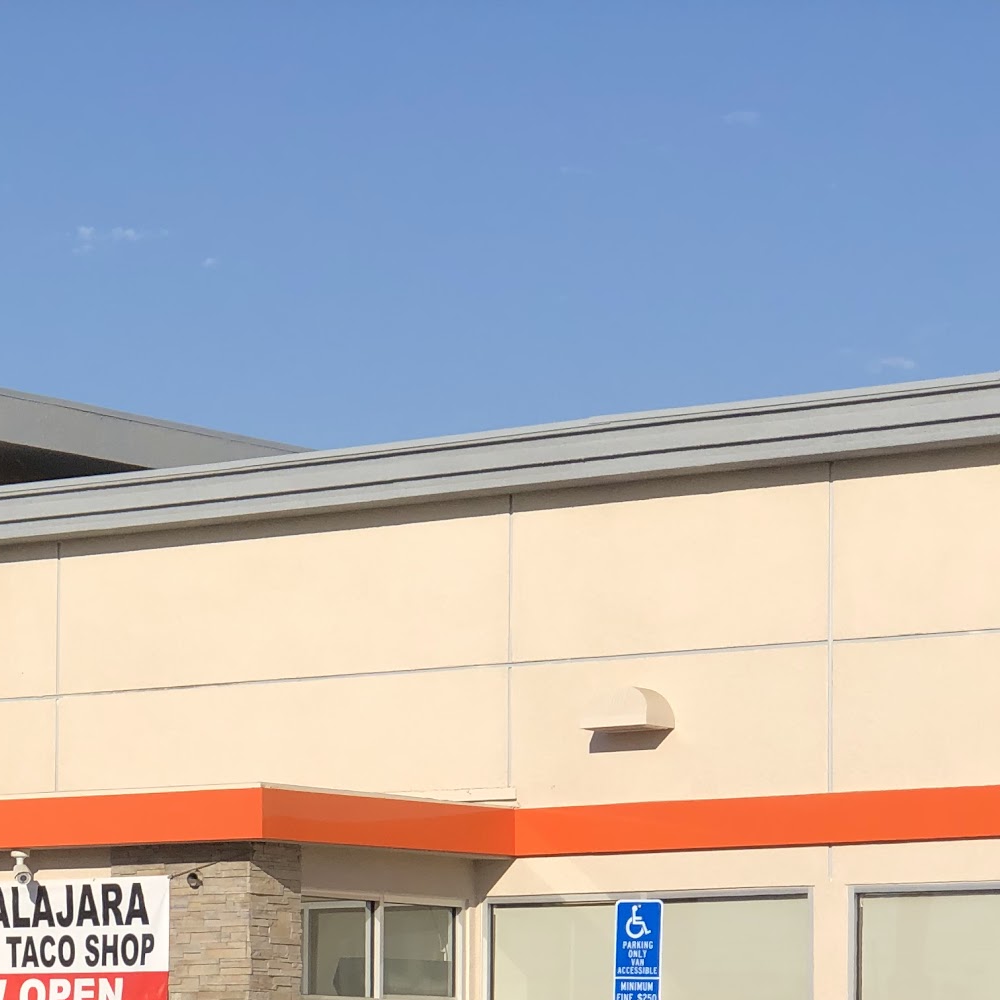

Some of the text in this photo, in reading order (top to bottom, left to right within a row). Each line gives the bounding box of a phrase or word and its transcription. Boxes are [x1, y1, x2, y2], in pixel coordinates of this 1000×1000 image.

[622, 941, 654, 950] PARKING
[5, 935, 76, 968] TACO
[85, 933, 156, 967] SHOP
[627, 950, 648, 959] ONLY
[630, 958, 645, 966] VAN
[617, 966, 658, 975] ACCESSIBLE
[620, 981, 654, 992] MINIMUM
